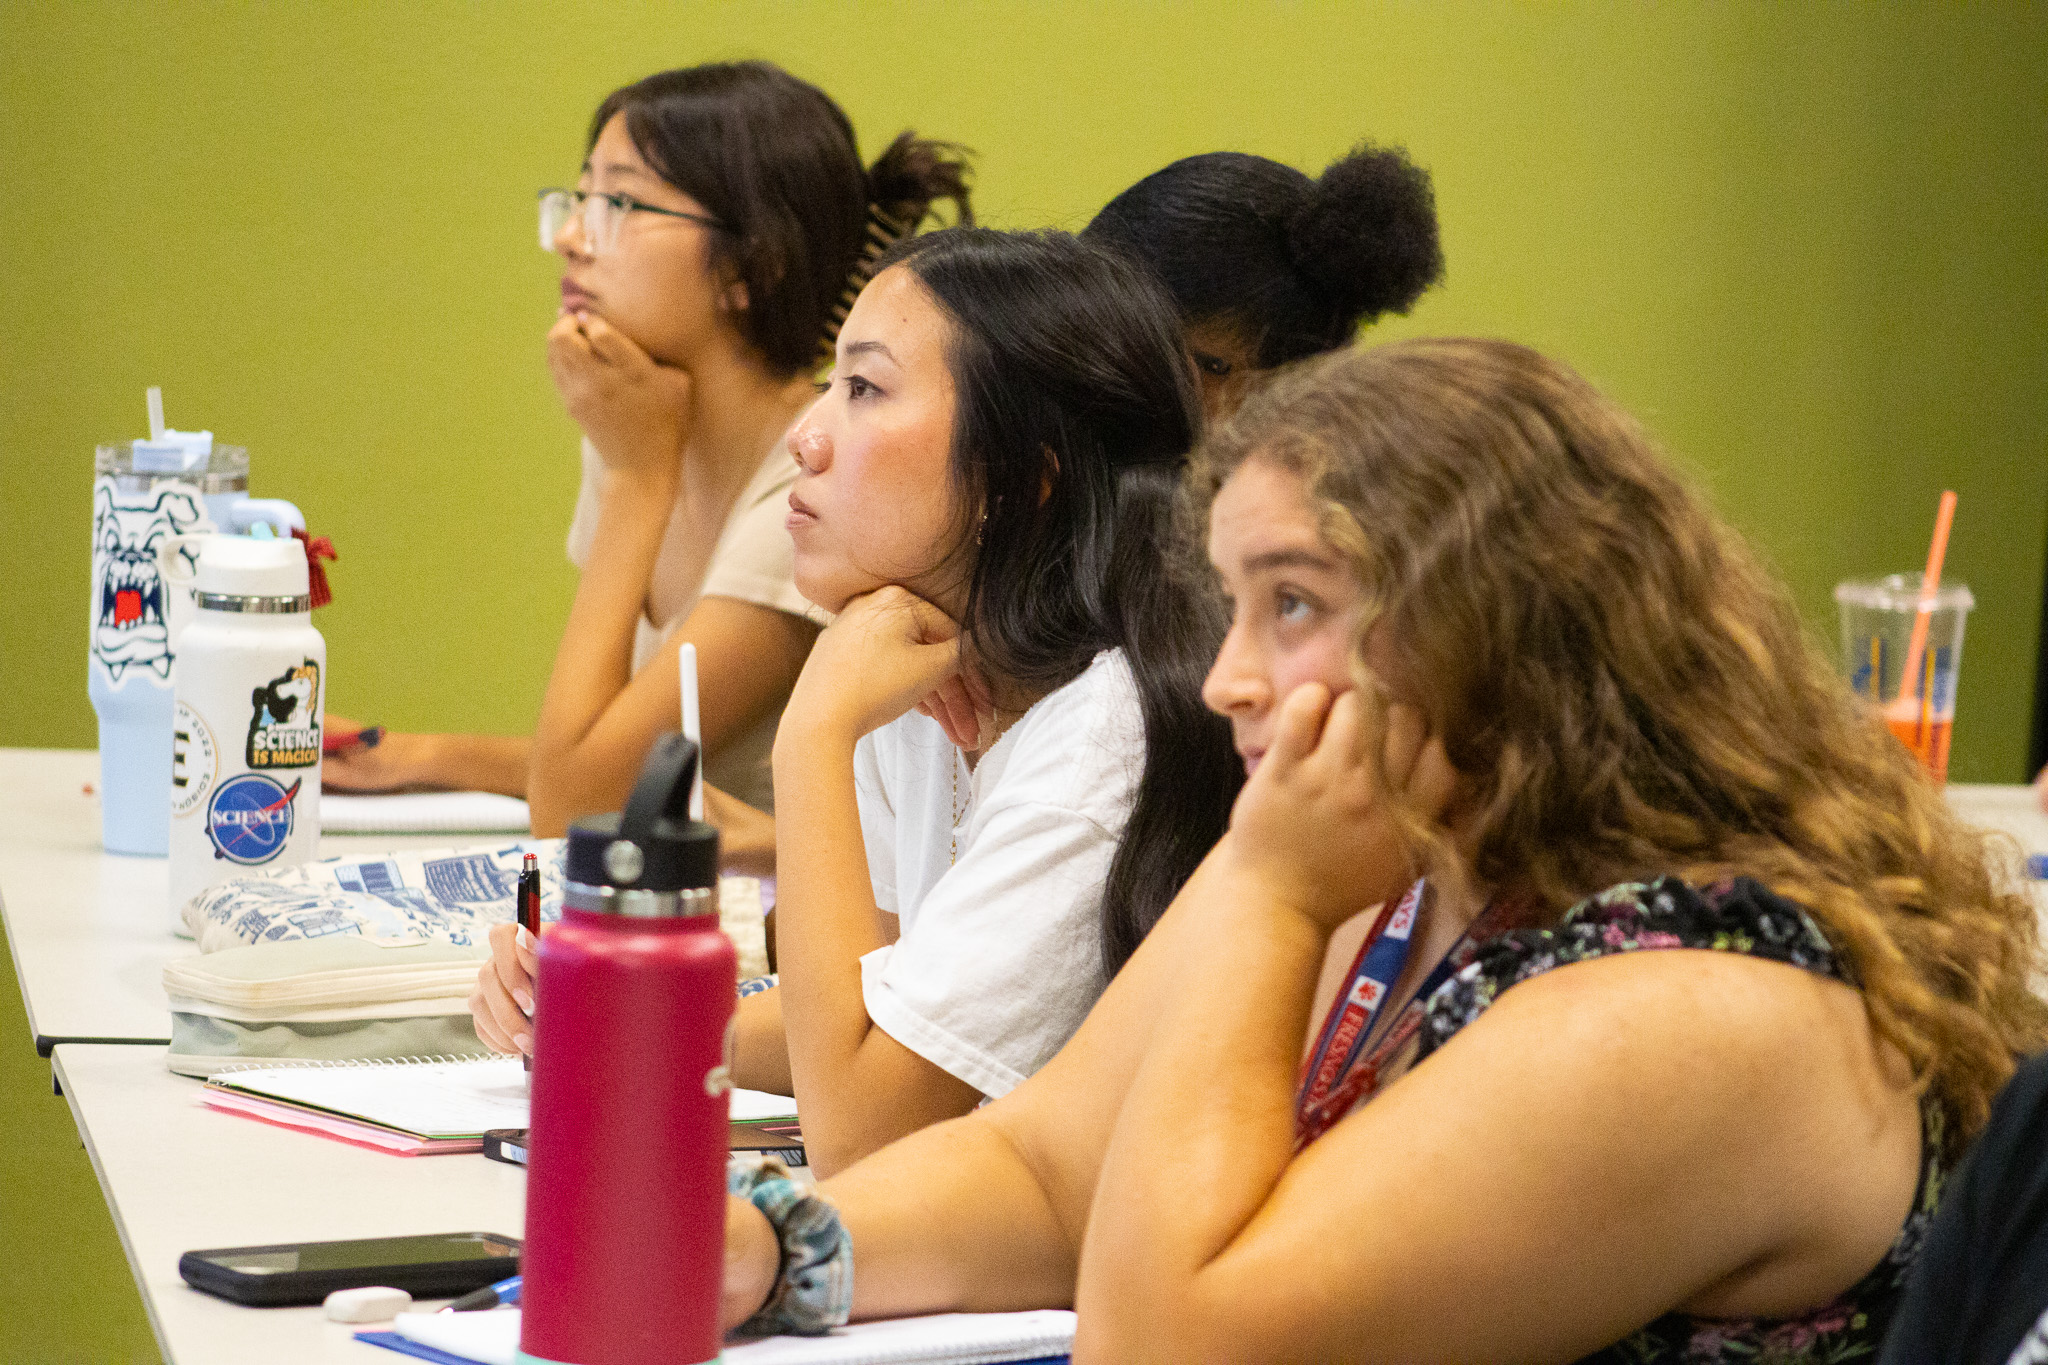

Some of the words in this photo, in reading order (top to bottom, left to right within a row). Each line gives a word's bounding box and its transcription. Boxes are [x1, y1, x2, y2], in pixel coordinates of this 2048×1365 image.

[191, 719, 213, 758] 2022
[253, 749, 269, 765] IS
[179, 772, 211, 810] EDISON
[213, 809, 288, 825] SCIENCE
[1317, 1010, 1364, 1083] FRESNO
